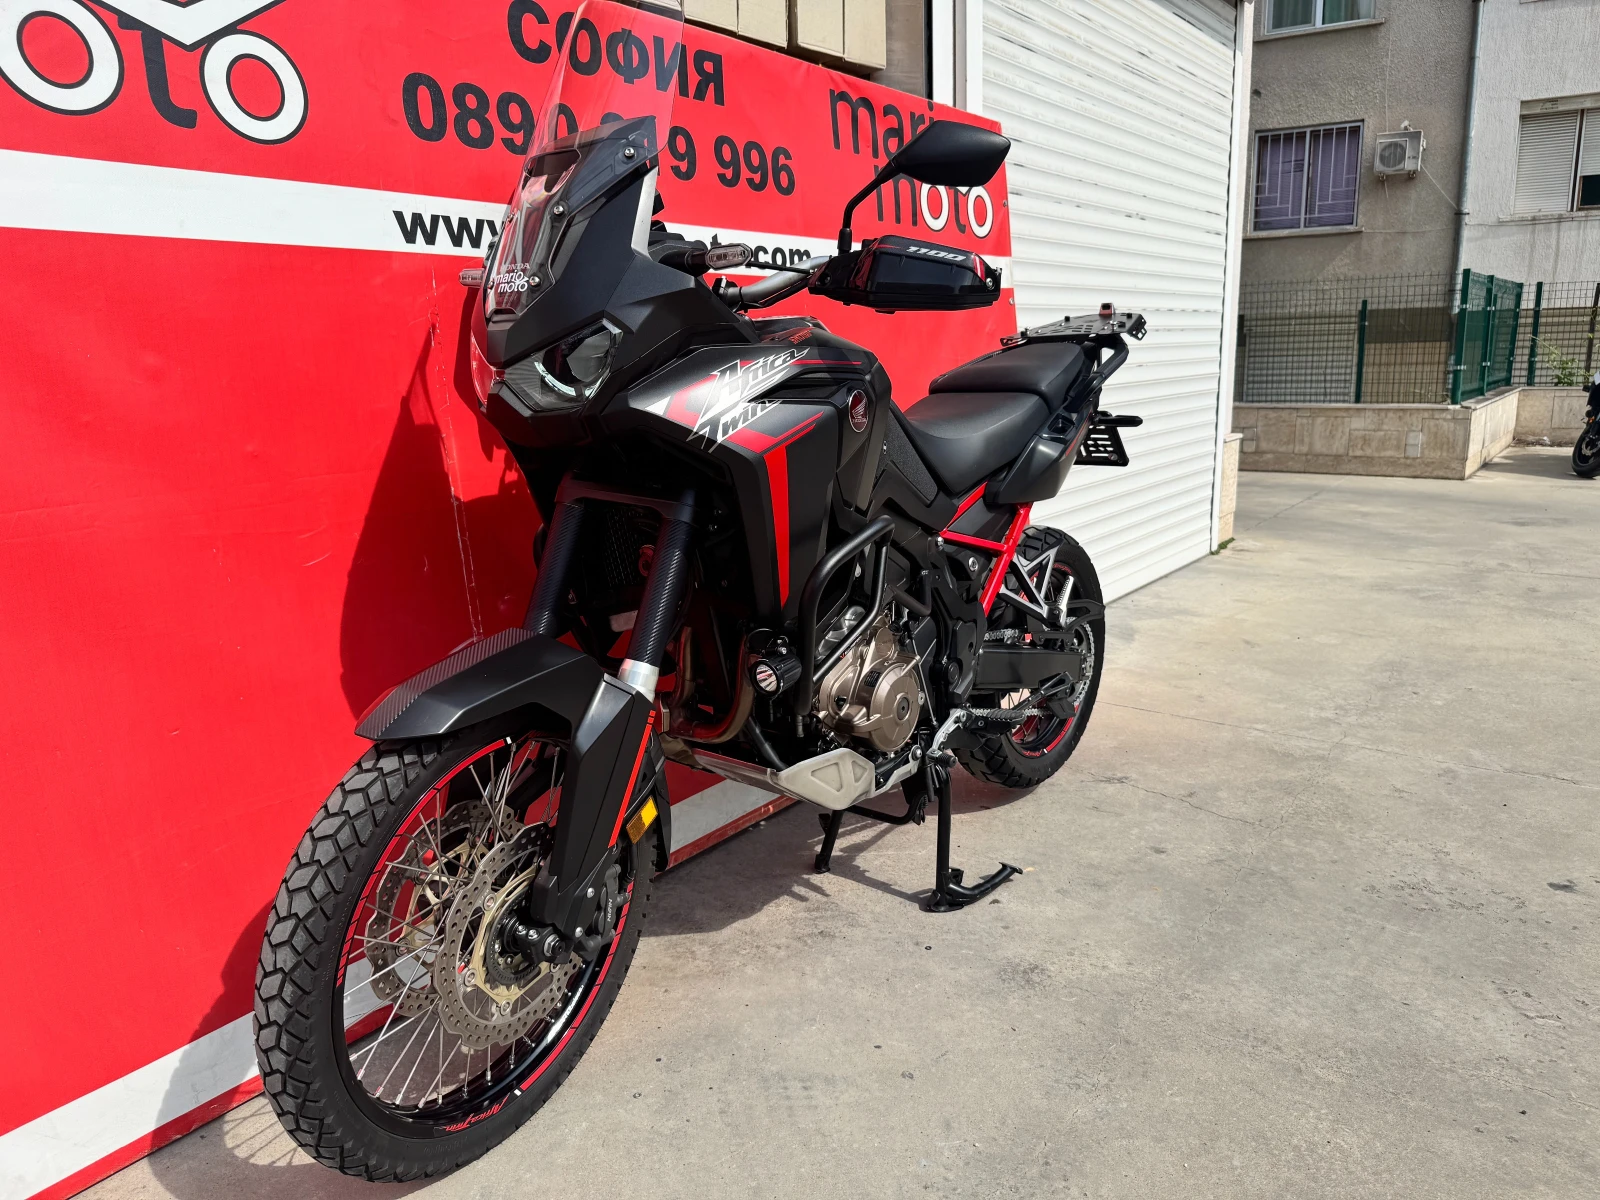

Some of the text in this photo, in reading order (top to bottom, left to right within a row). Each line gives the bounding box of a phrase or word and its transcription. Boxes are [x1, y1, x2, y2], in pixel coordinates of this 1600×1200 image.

[507, 0, 726, 107] СОФИЯ
[713, 134, 796, 197] 996
[906, 246, 966, 261] 1100
[495, 270, 524, 284] mario
[497, 280, 528, 293] moto
